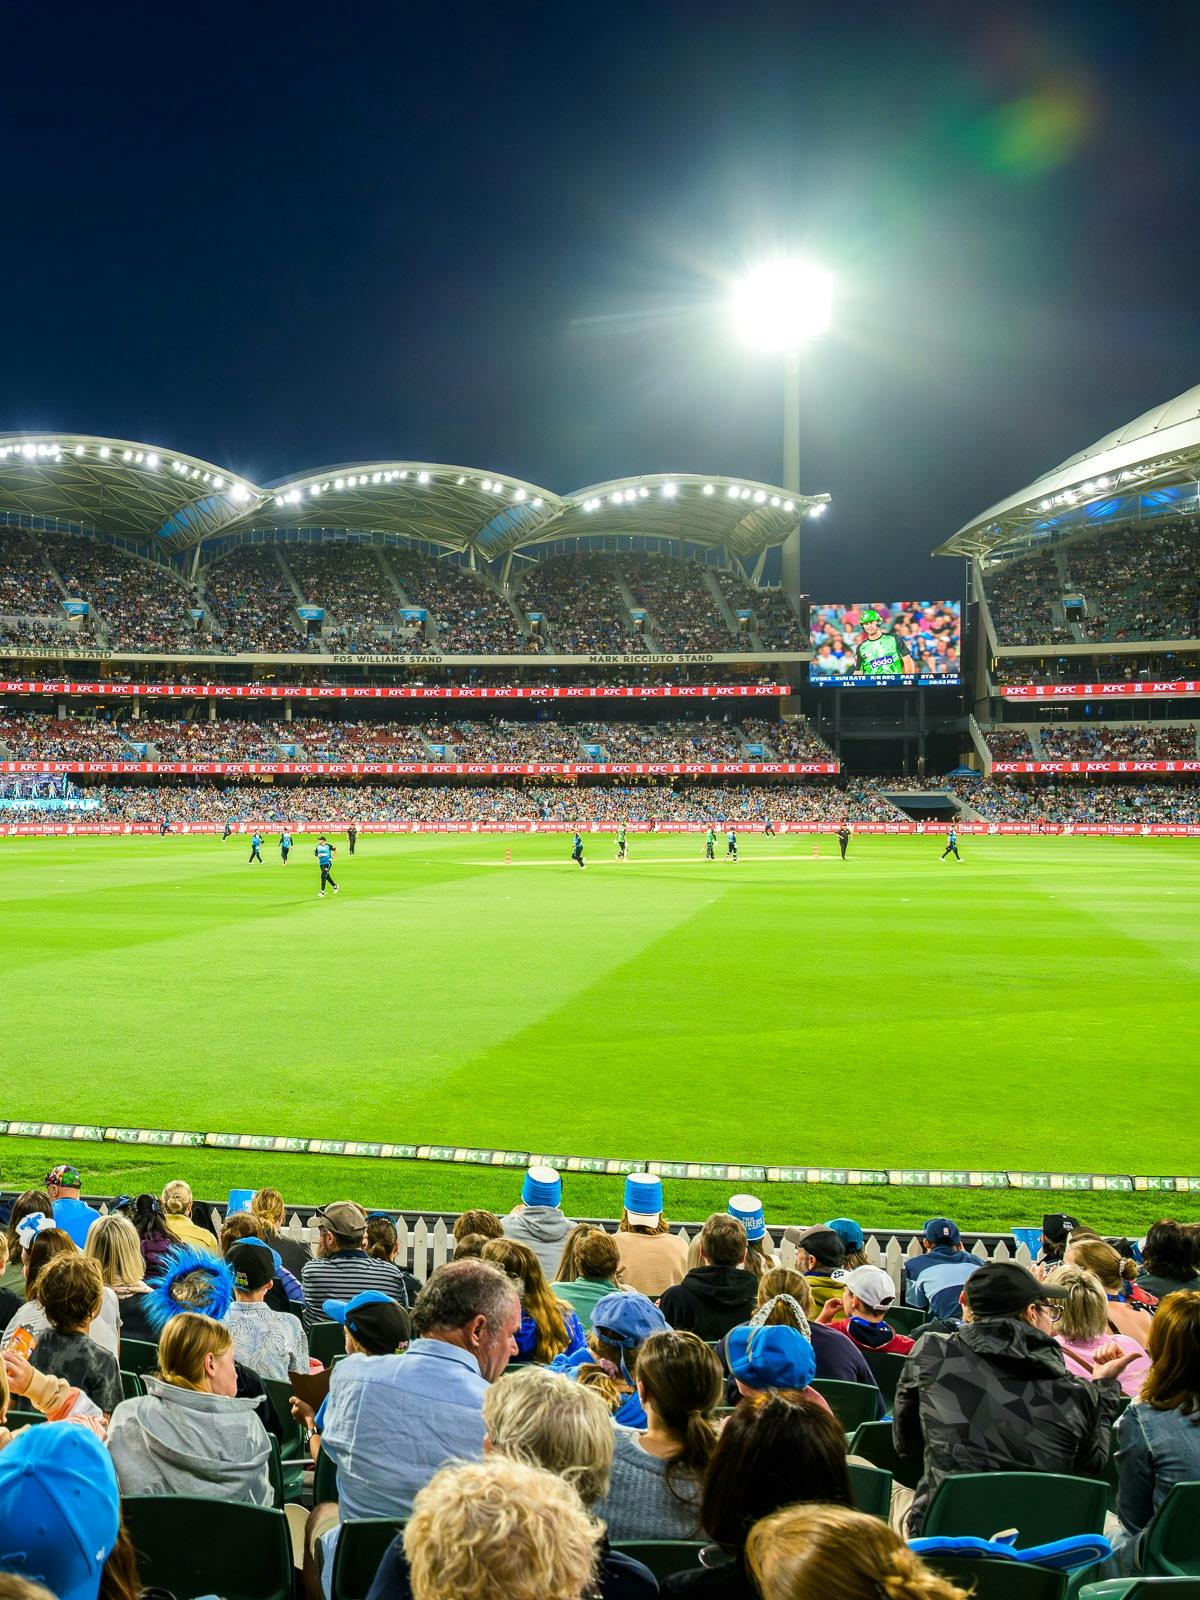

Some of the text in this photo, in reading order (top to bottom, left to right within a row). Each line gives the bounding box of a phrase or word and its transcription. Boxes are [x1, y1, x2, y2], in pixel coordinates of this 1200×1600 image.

[16, 648, 70, 658] BASHEER
[74, 650, 112, 659] STAND
[409, 656, 443, 664] STAND
[589, 654, 714, 663] MARK RICCIUTO STAND
[872, 657, 893, 668] dodo
[1006, 682, 1176, 695] KFC KFC KFC KFC
[503, 764, 521, 772] KFC
[995, 762, 1158, 771] KFC KFC KFC KFC
